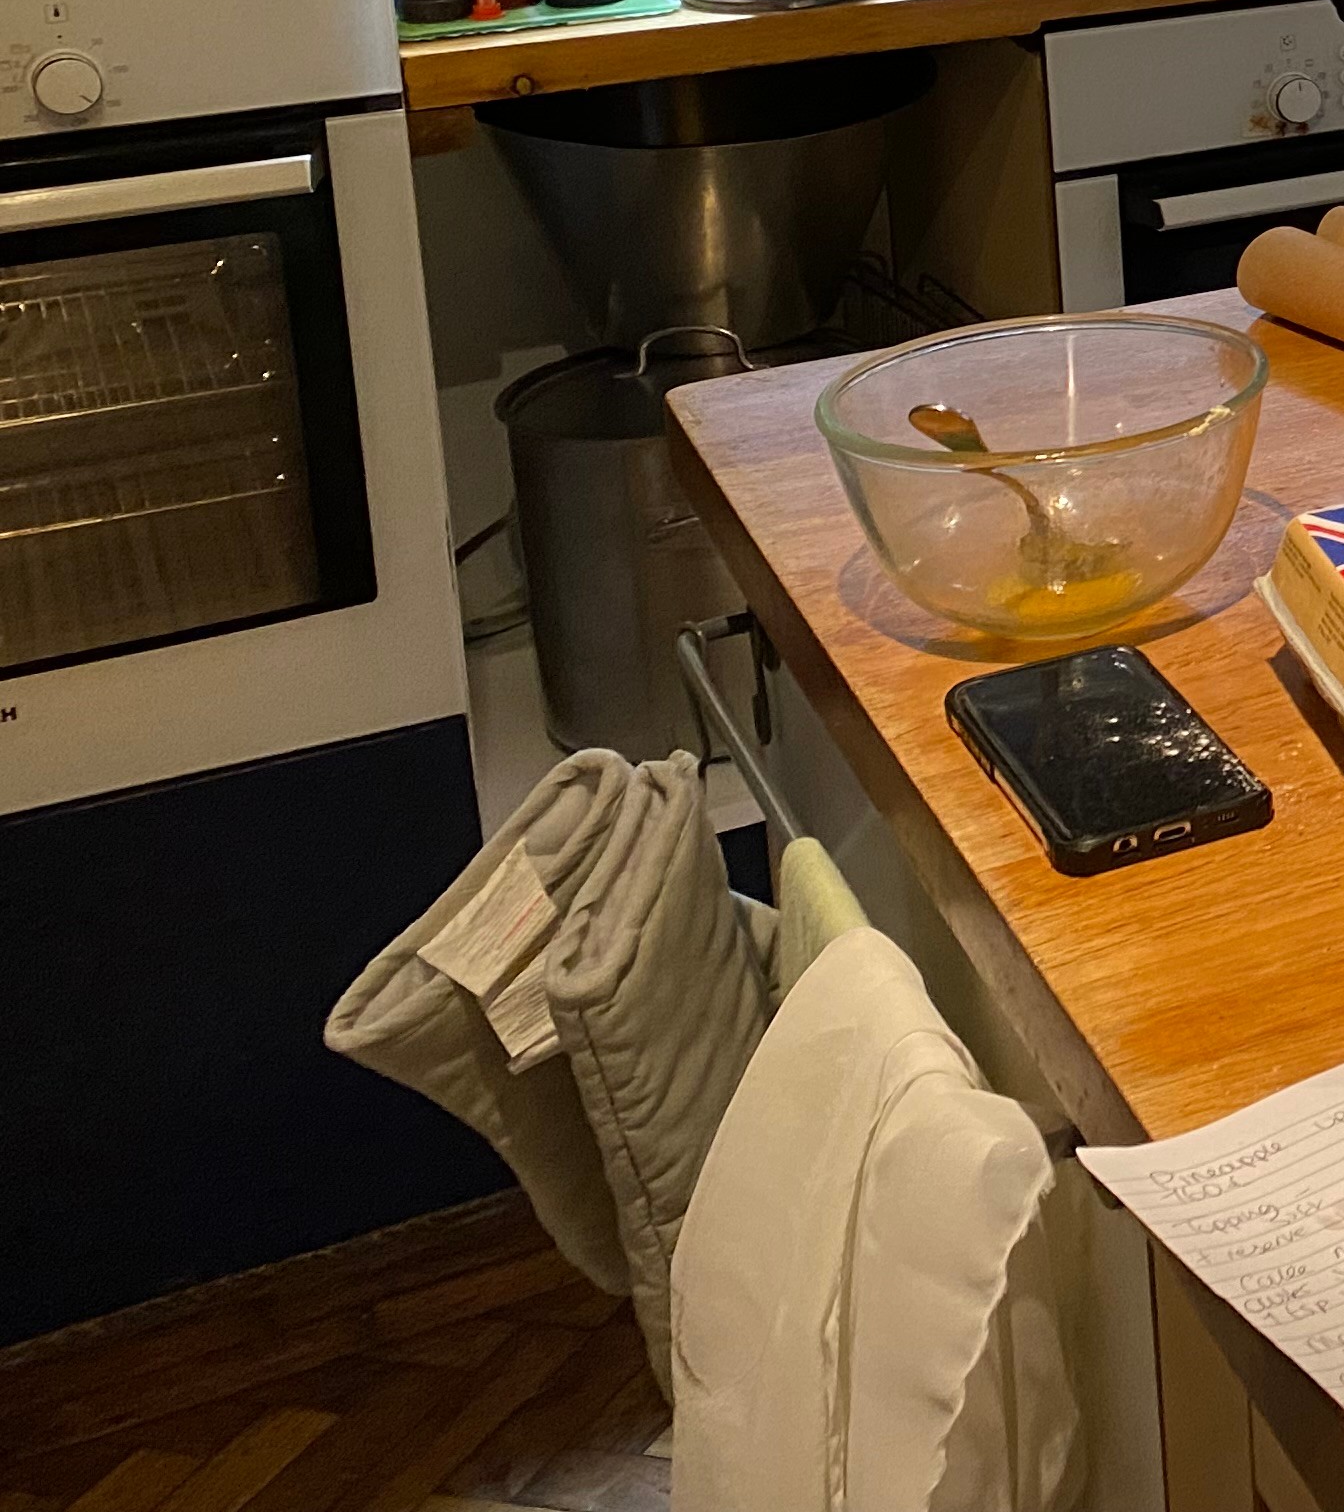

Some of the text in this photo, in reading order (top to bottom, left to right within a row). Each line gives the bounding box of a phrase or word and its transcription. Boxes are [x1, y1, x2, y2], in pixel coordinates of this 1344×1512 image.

[1149, 1137, 1283, 1196] Pineapple
[1176, 1195, 1280, 1246] Topping
[1227, 1227, 1305, 1260] reserve
